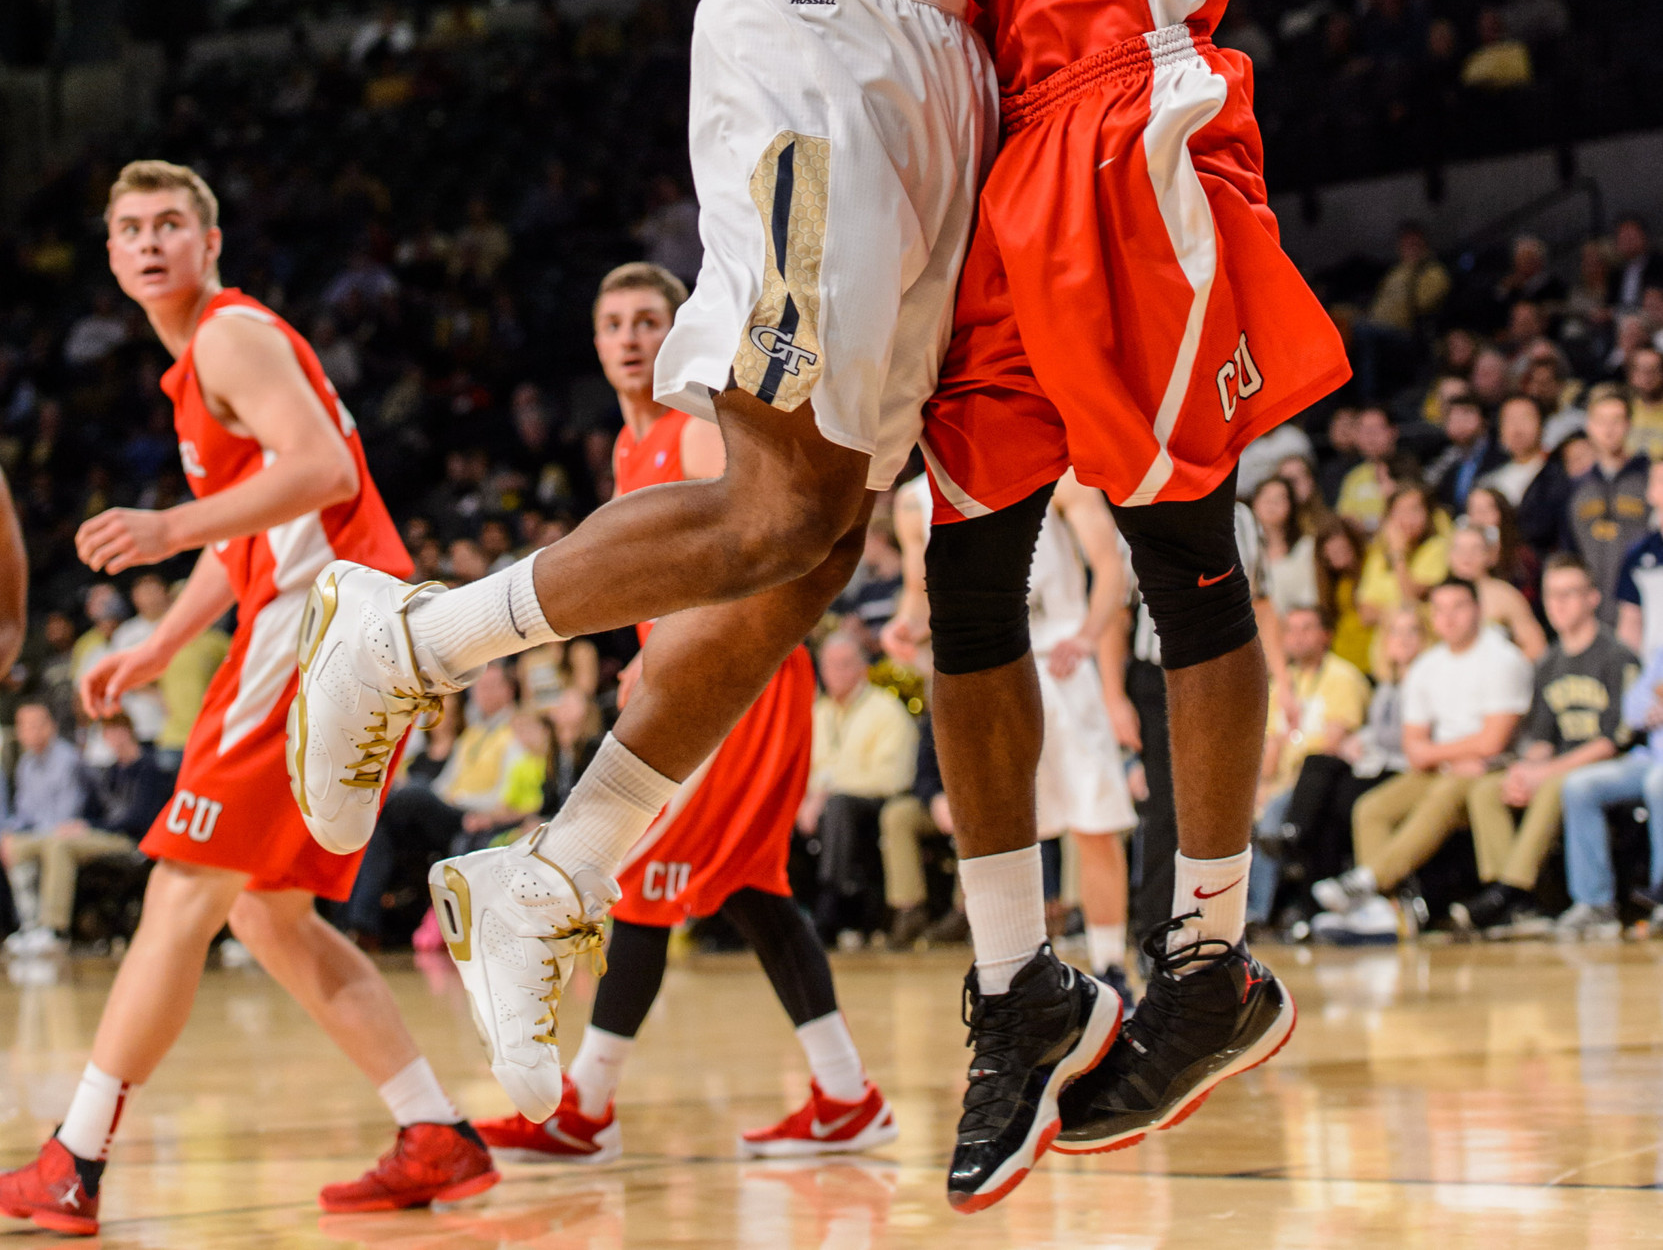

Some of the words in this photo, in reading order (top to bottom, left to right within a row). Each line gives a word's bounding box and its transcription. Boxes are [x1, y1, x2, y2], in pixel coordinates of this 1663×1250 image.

[750, 325, 818, 377] GT
[1216, 329, 1264, 424] CU
[165, 789, 224, 843] CU
[642, 860, 692, 903] CU
